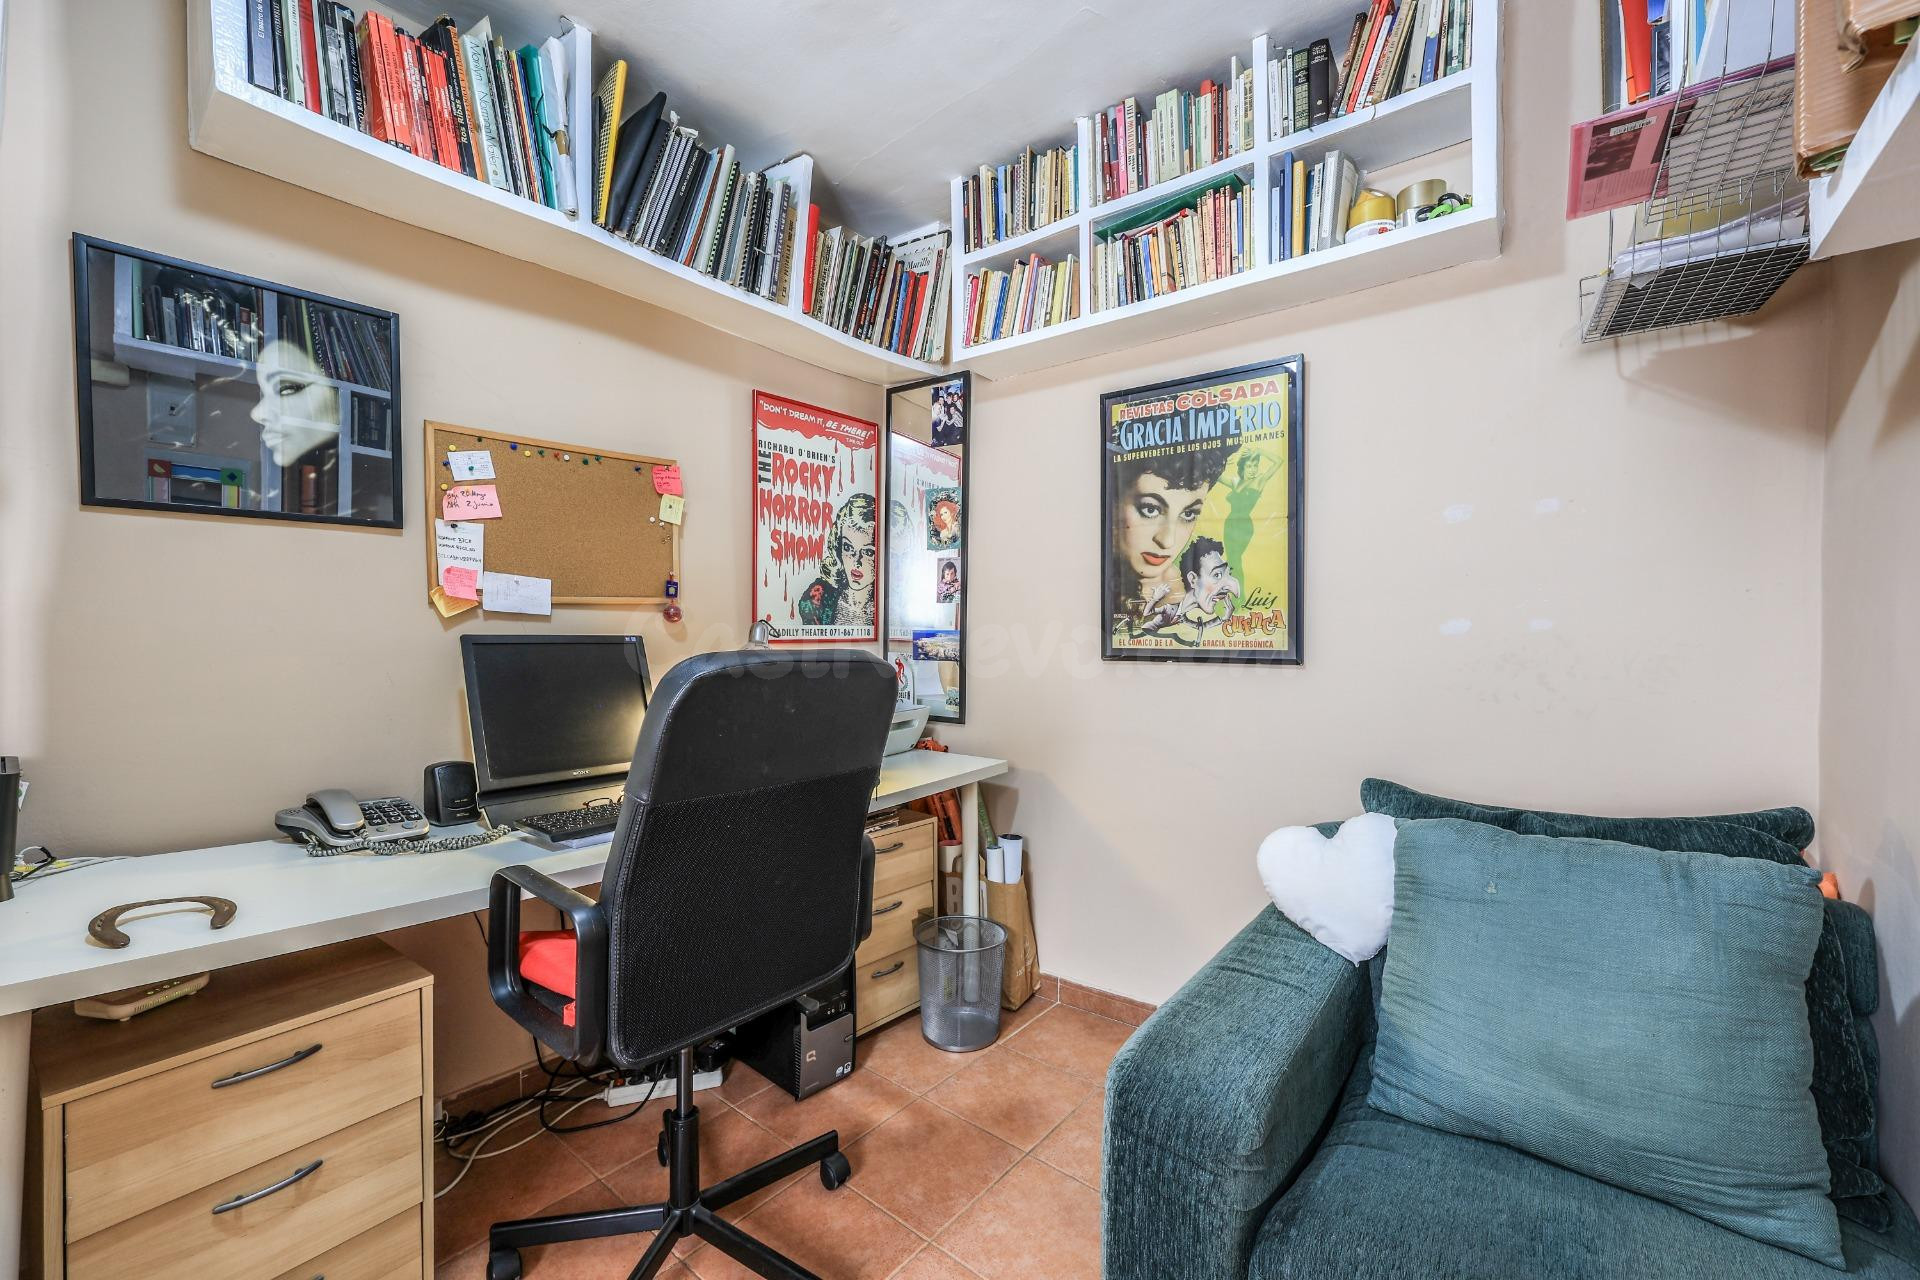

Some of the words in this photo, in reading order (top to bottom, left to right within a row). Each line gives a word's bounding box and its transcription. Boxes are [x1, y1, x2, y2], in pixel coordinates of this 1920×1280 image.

[257, 31, 265, 39] El
[470, 40, 485, 82] Marilyn
[456, 98, 466, 126] Ribas
[1119, 400, 1174, 421] REVISTAS
[1175, 380, 1281, 412] COLSADA
[788, 409, 816, 424] DREAM
[826, 420, 838, 430] BE
[1119, 414, 1183, 452] GRACIA
[1188, 400, 1282, 441] IMPERIO
[758, 439, 794, 455] RICHARD
[798, 448, 836, 464] O'BRIEN'S
[1113, 455, 1122, 464] LA
[1123, 445, 1175, 463] SUPERVEDETTE
[1176, 443, 1187, 454] DE
[1187, 441, 1201, 453] LOS
[1202, 439, 1222, 451] OJOS
[1226, 430, 1285, 448] MUSULMANES
[758, 449, 771, 484] THE
[771, 452, 835, 494] ROCKY
[760, 487, 834, 528] HORROR
[771, 529, 825, 566] SHOW
[1241, 586, 1278, 610] Luis
[801, 628, 828, 638] THEATRE
[829, 628, 855, 638] 071-867
[856, 628, 871, 637] 1118
[1222, 609, 1287, 637] CUENCA
[1118, 639, 1128, 648] EL
[1154, 638, 1165, 648] DE
[1165, 638, 1173, 647] LA
[1202, 638, 1226, 648] GRACIA
